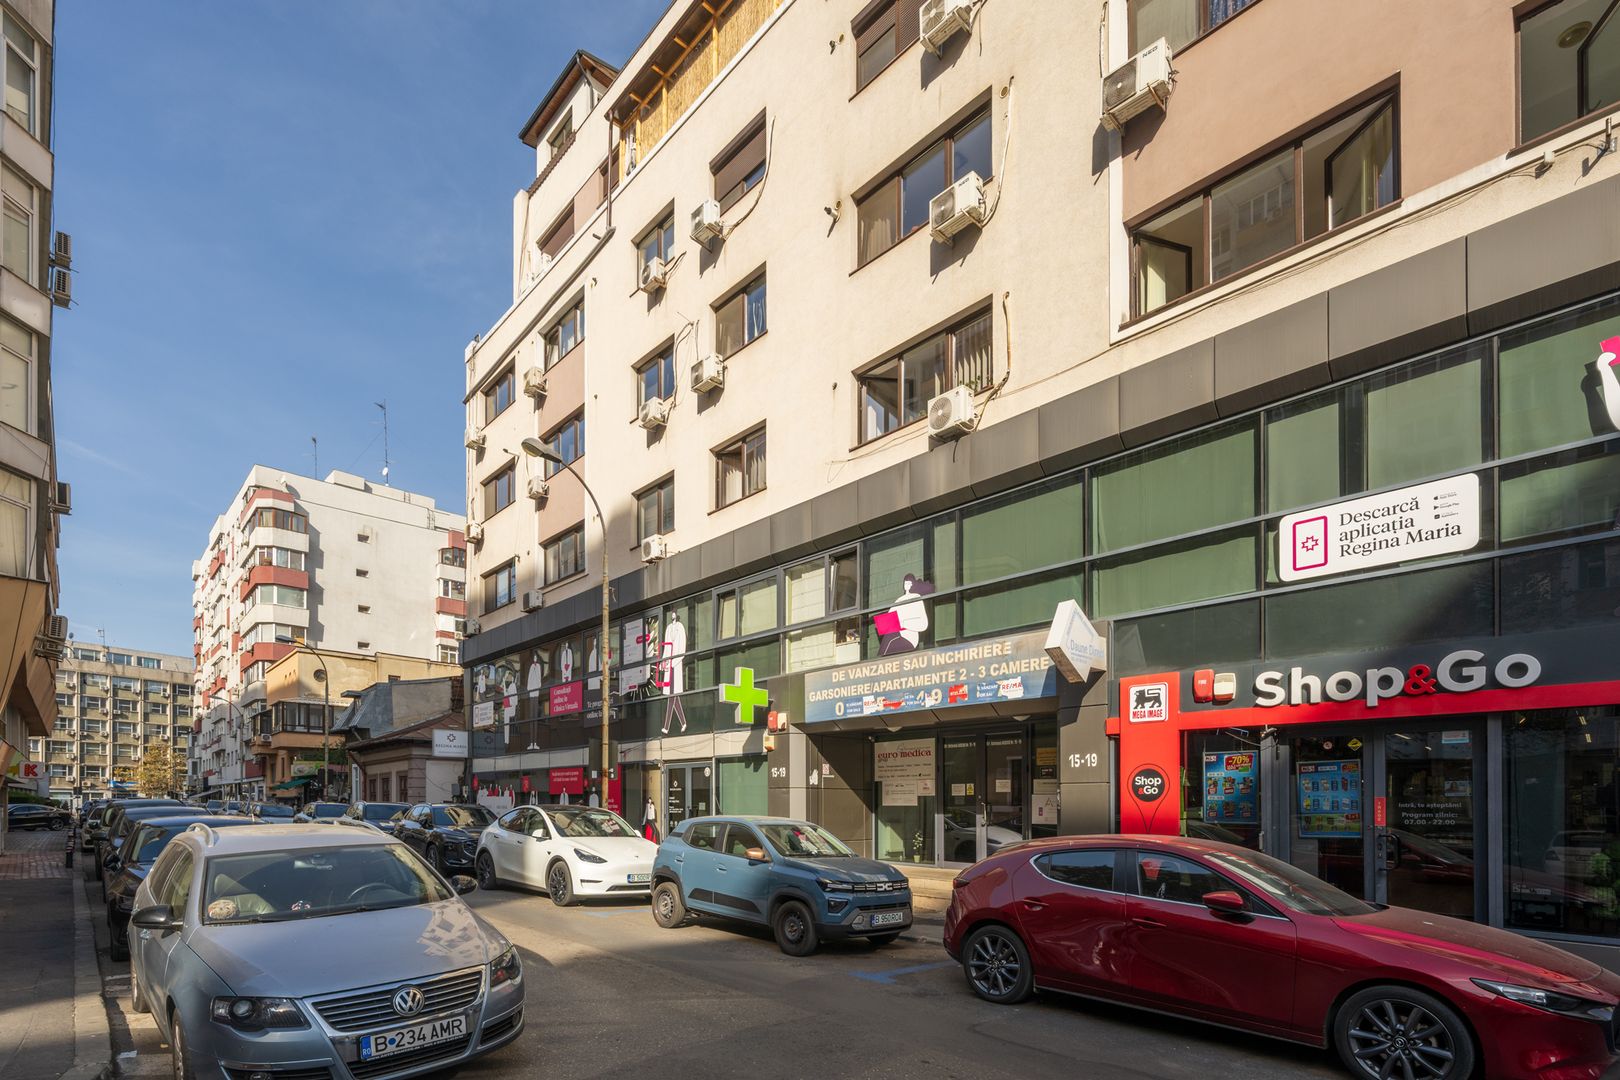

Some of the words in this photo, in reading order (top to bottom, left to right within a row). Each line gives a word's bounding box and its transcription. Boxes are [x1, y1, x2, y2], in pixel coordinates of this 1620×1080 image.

[1339, 496, 1420, 527] Descarcă
[1339, 516, 1415, 543] aplicația
[1339, 536, 1400, 557] Regina
[1406, 523, 1462, 545] Maria
[832, 670, 846, 682] DE
[848, 661, 900, 680] VANZARE
[903, 656, 928, 670] SAU
[932, 641, 1012, 666] INCHIRIERE
[809, 670, 956, 702] GARSONIERE/APARTAMENTE
[960, 668, 967, 680] 2
[978, 666, 986, 678] 3
[990, 656, 1050, 676] CAMERE
[1254, 650, 1541, 707] Shop&Go
[1132, 710, 1146, 719] MEGA
[1147, 709, 1163, 718] IMAGE
[900, 749, 932, 758] medica
[1068, 753, 1098, 768] 15-19
[1228, 756, 1250, 764] -70%
[24, 763, 38, 776] K
[771, 767, 786, 778] 15-19
[1135, 776, 1162, 786] Shop
[1138, 786, 1158, 795] &Go
[375, 1036, 388, 1052] B
[395, 1027, 426, 1048] 234
[430, 1018, 462, 1040] AMR
